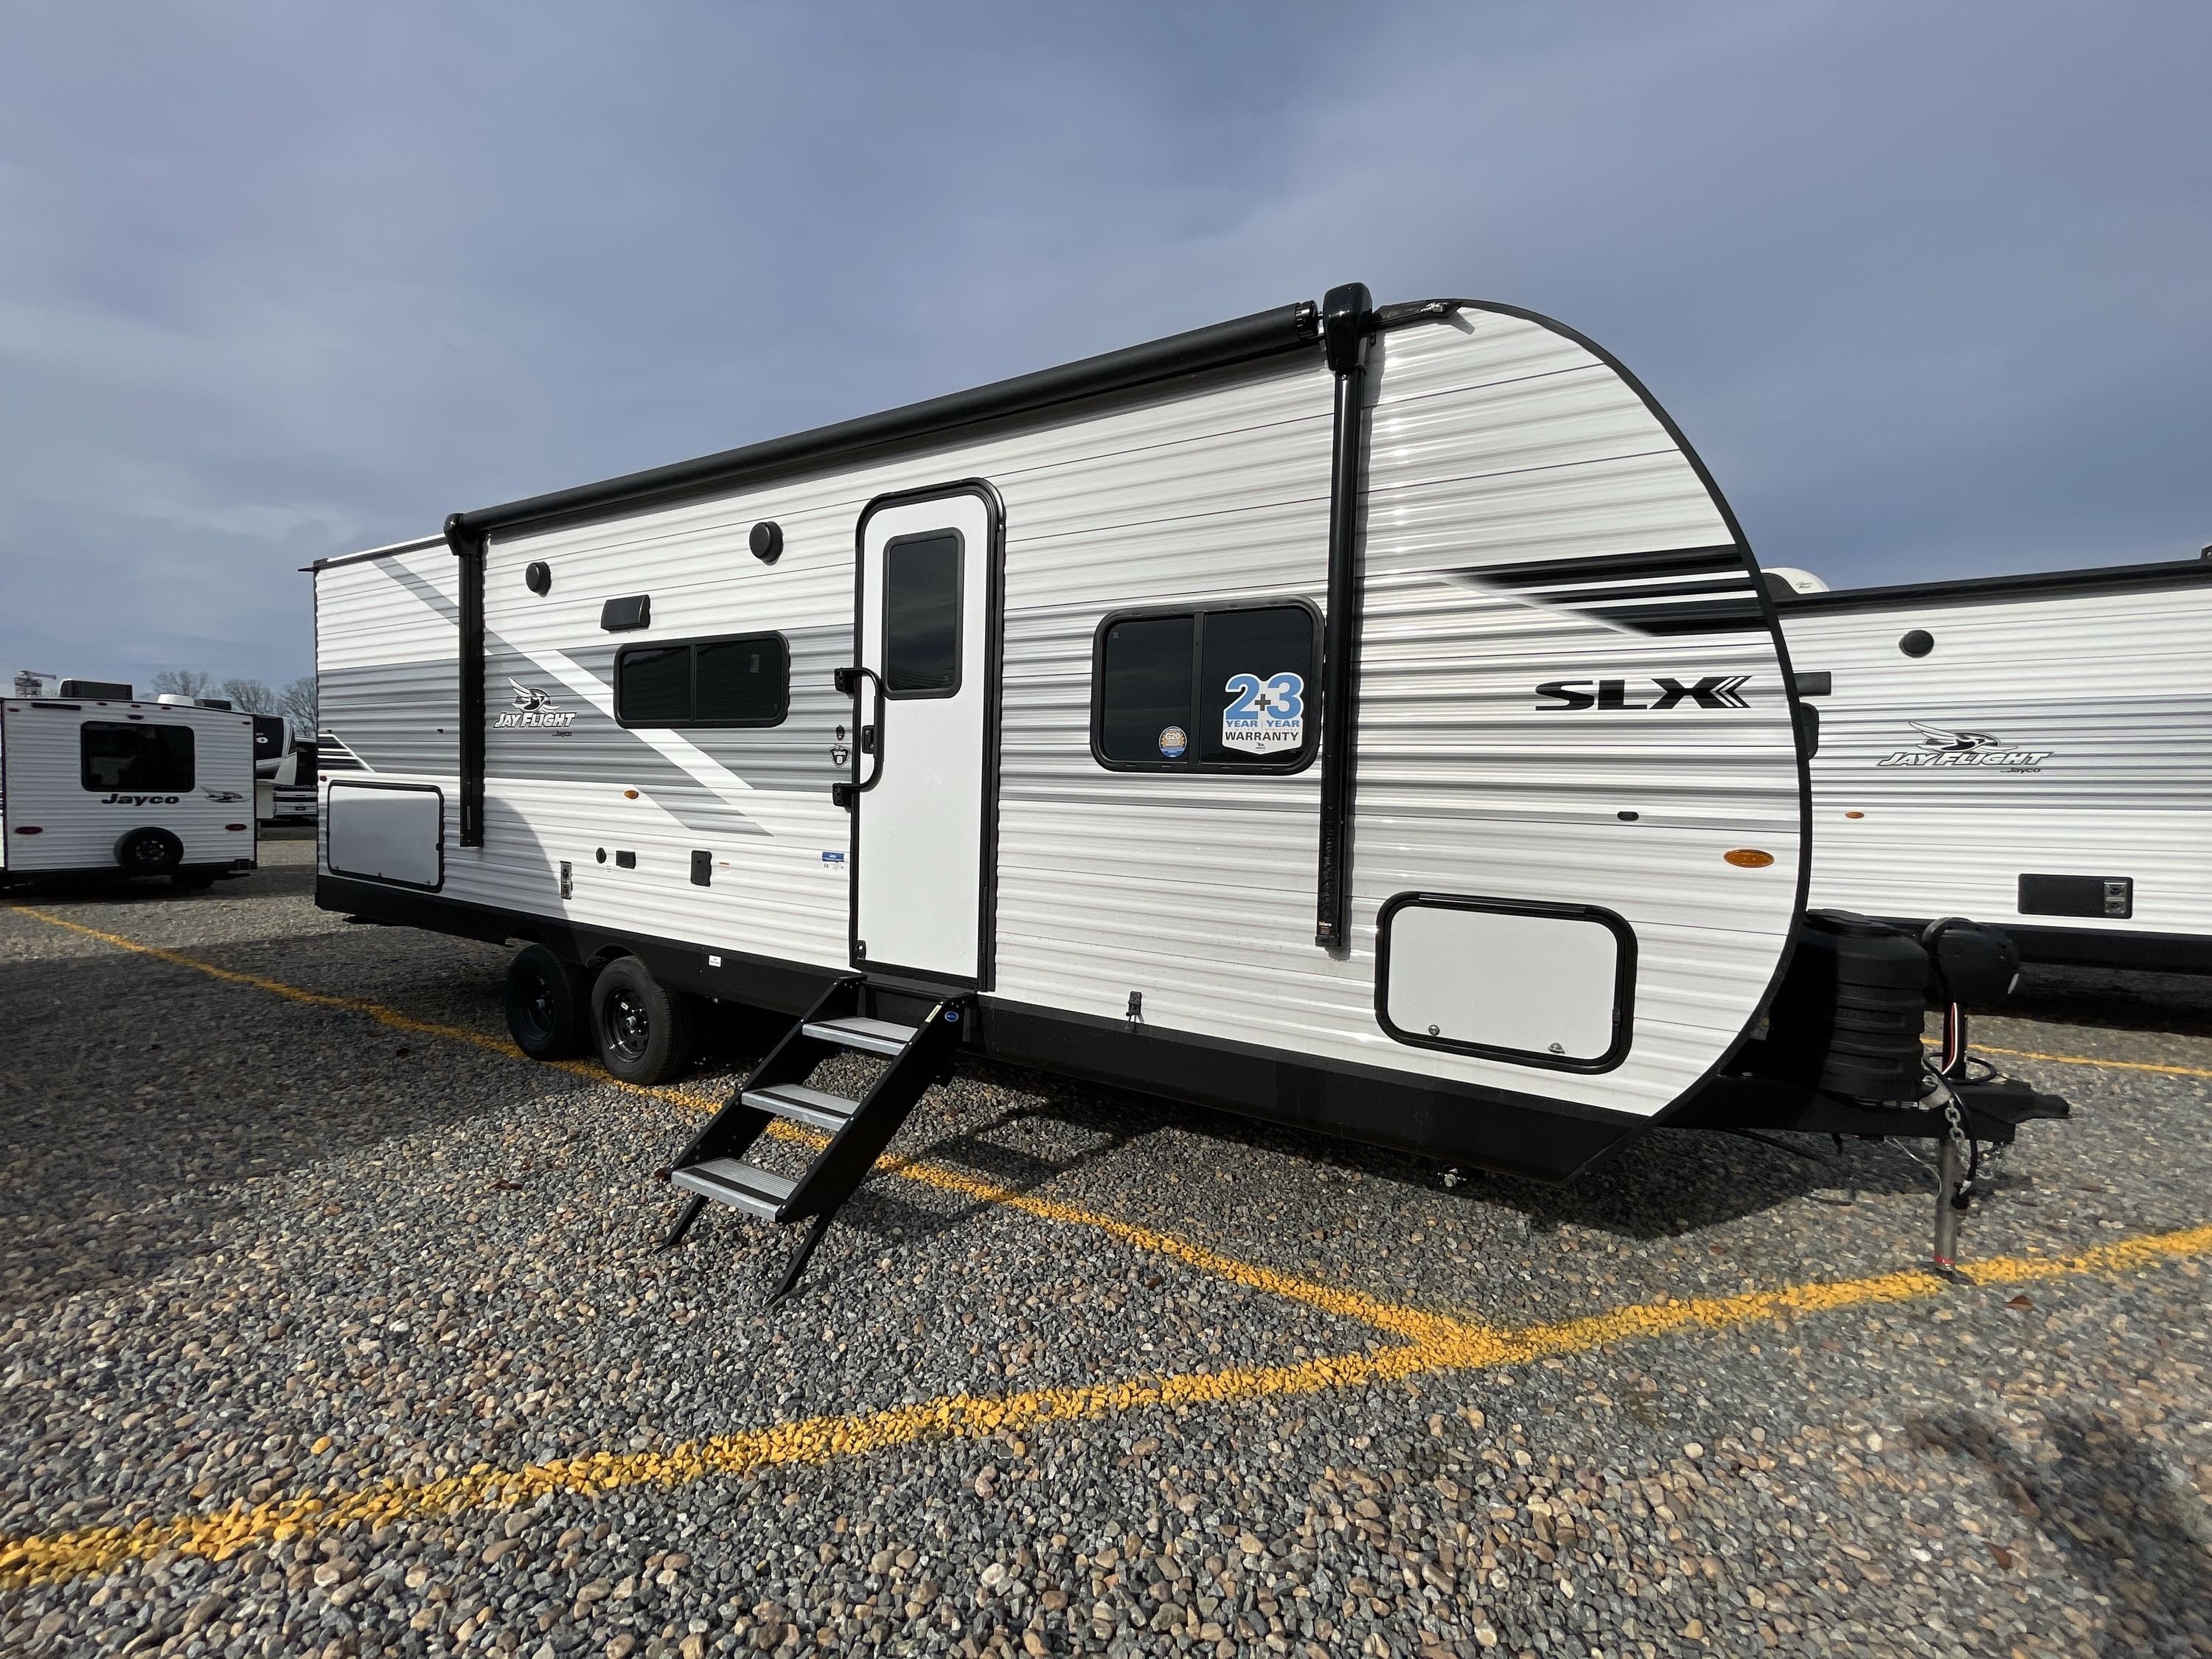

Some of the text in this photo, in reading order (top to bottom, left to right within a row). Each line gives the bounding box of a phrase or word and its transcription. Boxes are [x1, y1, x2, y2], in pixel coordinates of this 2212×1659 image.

[1535, 675, 1753, 711] SLX
[493, 712, 577, 728] JAY FLIGHT
[1225, 732, 1299, 741] WARRANTY
[1879, 751, 2053, 766] JAY FLIGHT
[101, 793, 179, 806] Jayco
